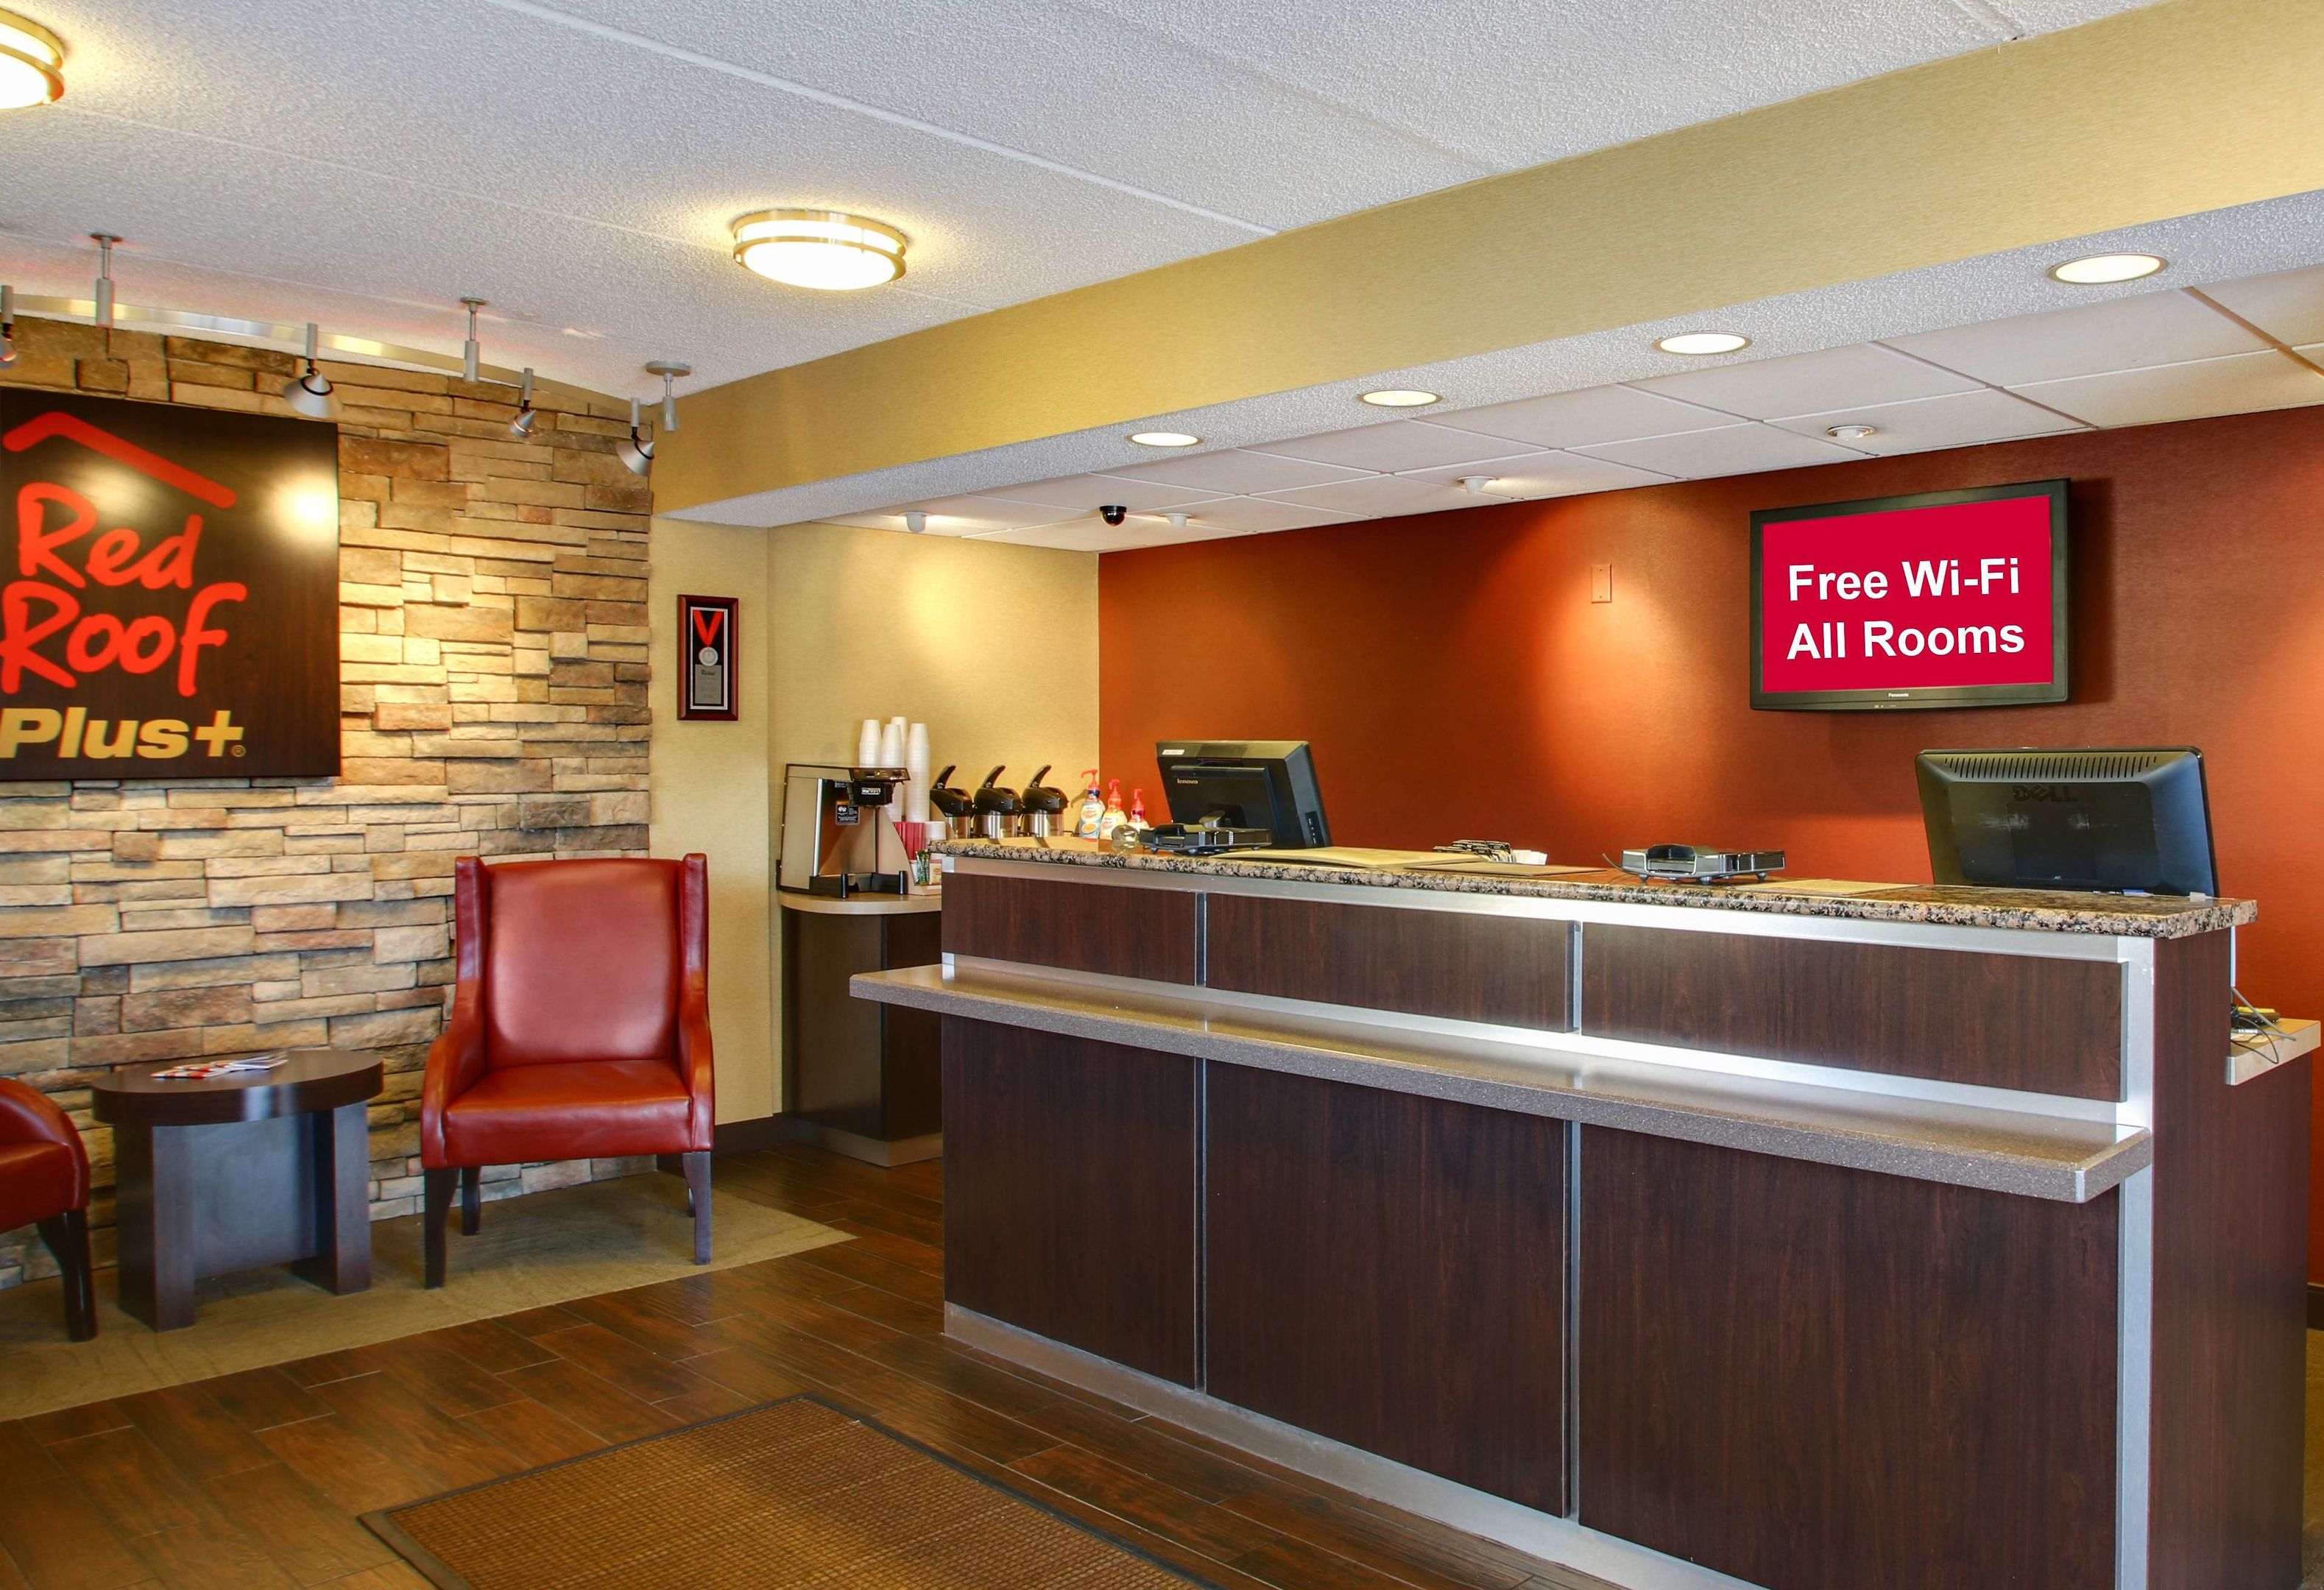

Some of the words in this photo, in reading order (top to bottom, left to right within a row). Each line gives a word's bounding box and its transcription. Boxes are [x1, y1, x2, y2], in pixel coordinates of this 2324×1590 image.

[17, 481, 203, 590] Red
[1789, 564, 1888, 601] Free
[1901, 557, 2019, 598] Wi-Fi
[0, 580, 247, 697] Roof
[1787, 622, 1846, 660] All
[1864, 621, 2024, 657] Rooms
[2012, 784, 2078, 803] DELL
